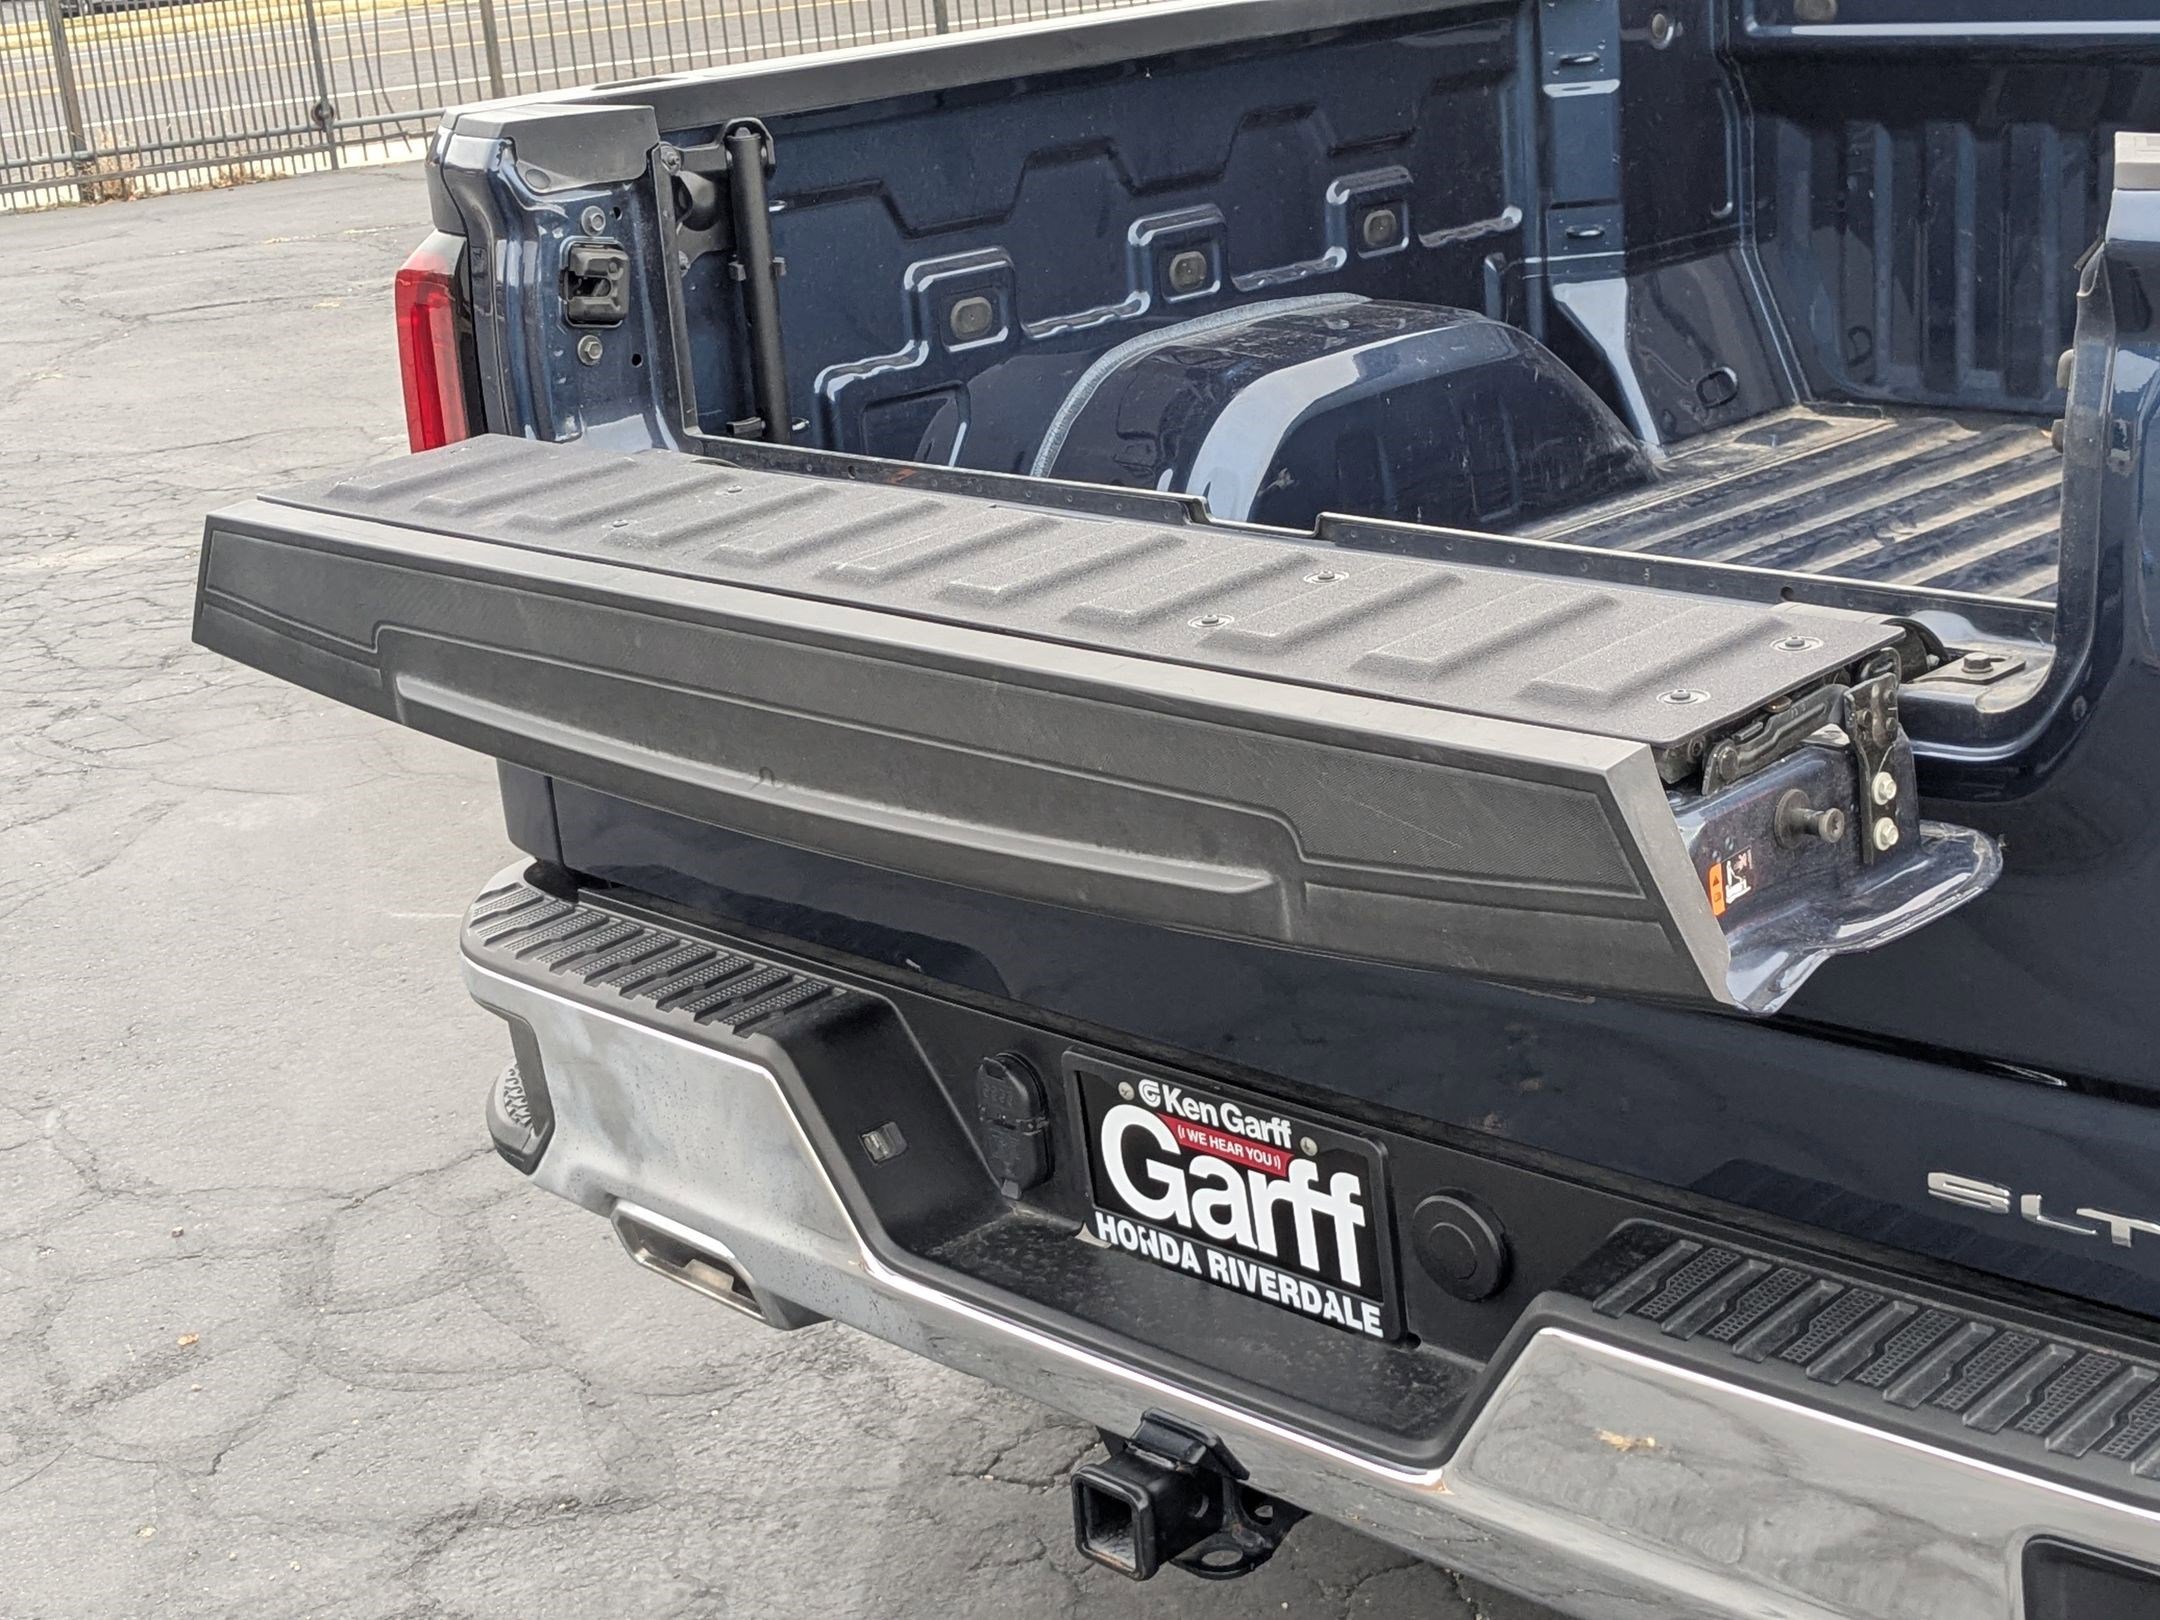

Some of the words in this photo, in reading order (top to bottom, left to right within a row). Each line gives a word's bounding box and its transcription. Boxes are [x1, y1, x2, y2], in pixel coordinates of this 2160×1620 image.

[1162, 1084, 1219, 1127] Ken
[1220, 1103, 1292, 1148] Garff
[1186, 1131, 1207, 1146] WE
[1209, 1139, 1244, 1158] HEAR
[1246, 1149, 1272, 1167] YOU
[1101, 1104, 1366, 1287] Garff
[1928, 1172, 2160, 1248] SLT
[1095, 1211, 1202, 1275] HONDA
[1206, 1248, 1384, 1338] RIVERDALE
